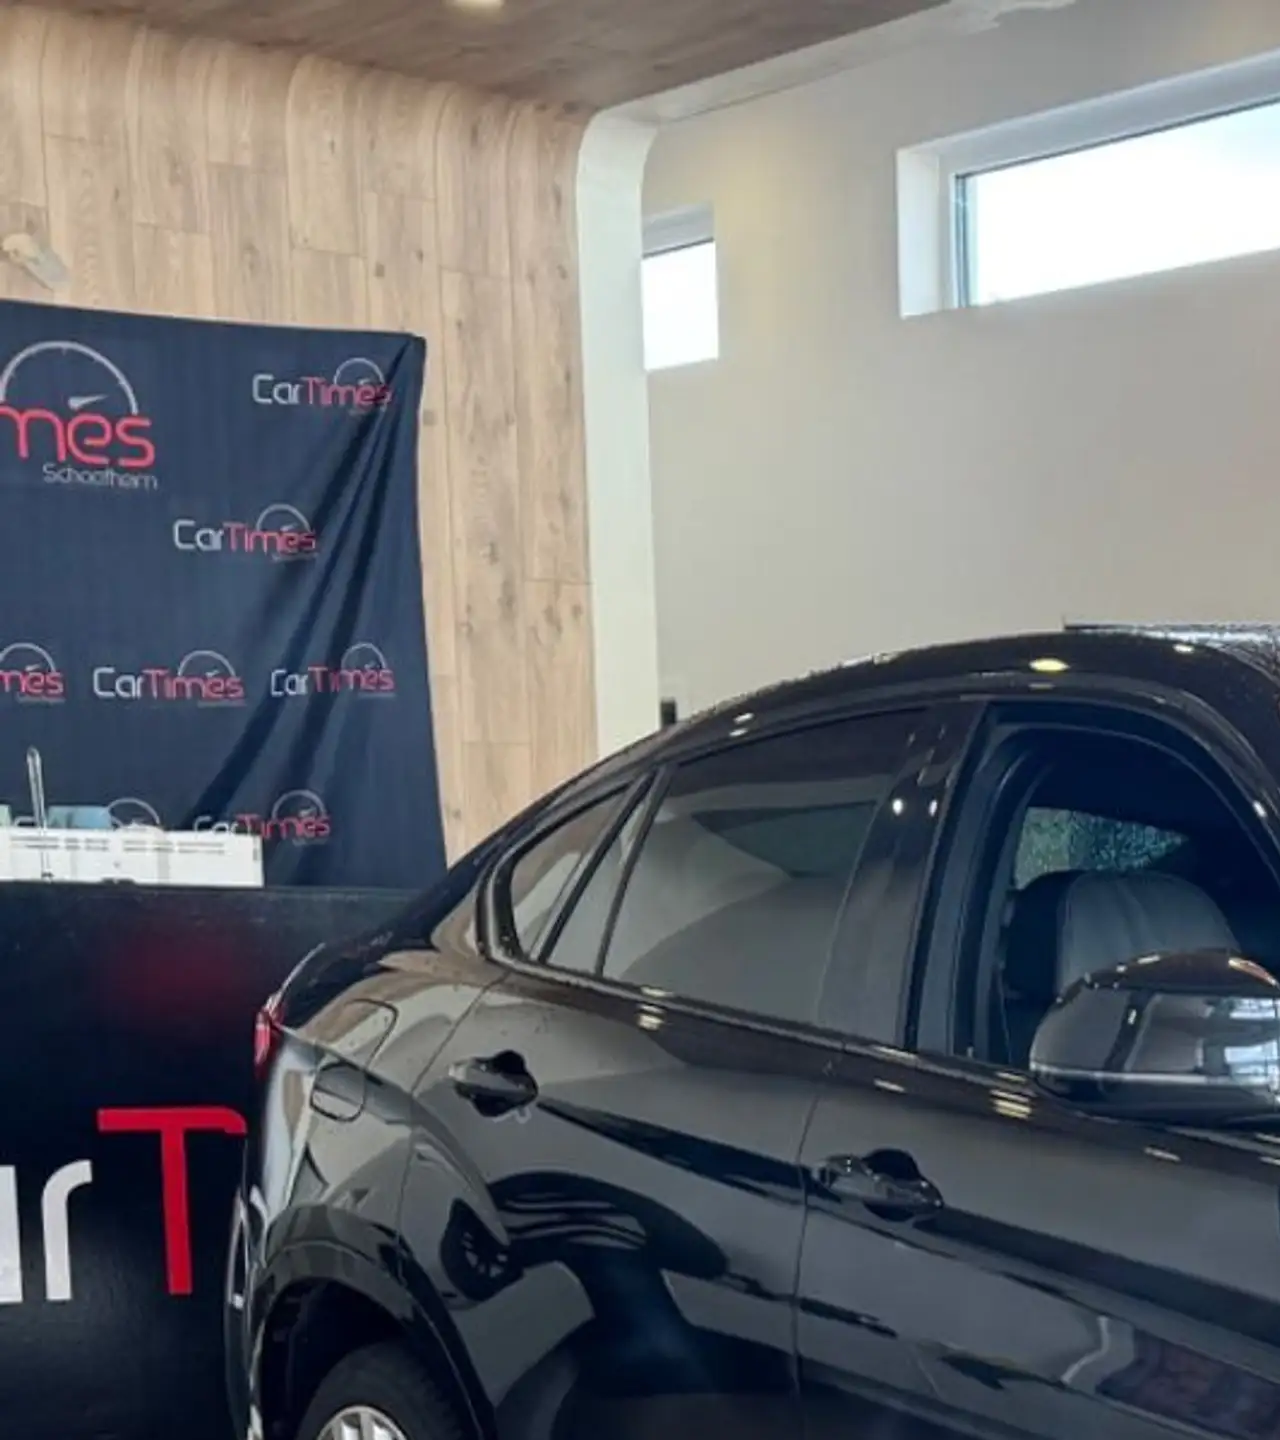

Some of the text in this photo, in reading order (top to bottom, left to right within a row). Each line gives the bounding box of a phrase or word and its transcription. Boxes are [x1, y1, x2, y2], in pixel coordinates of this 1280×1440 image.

[252, 373, 392, 406] CarTimes
[173, 519, 316, 554] CarTimes
[93, 667, 244, 699] CarTimes
[271, 667, 396, 697] CarTimes
